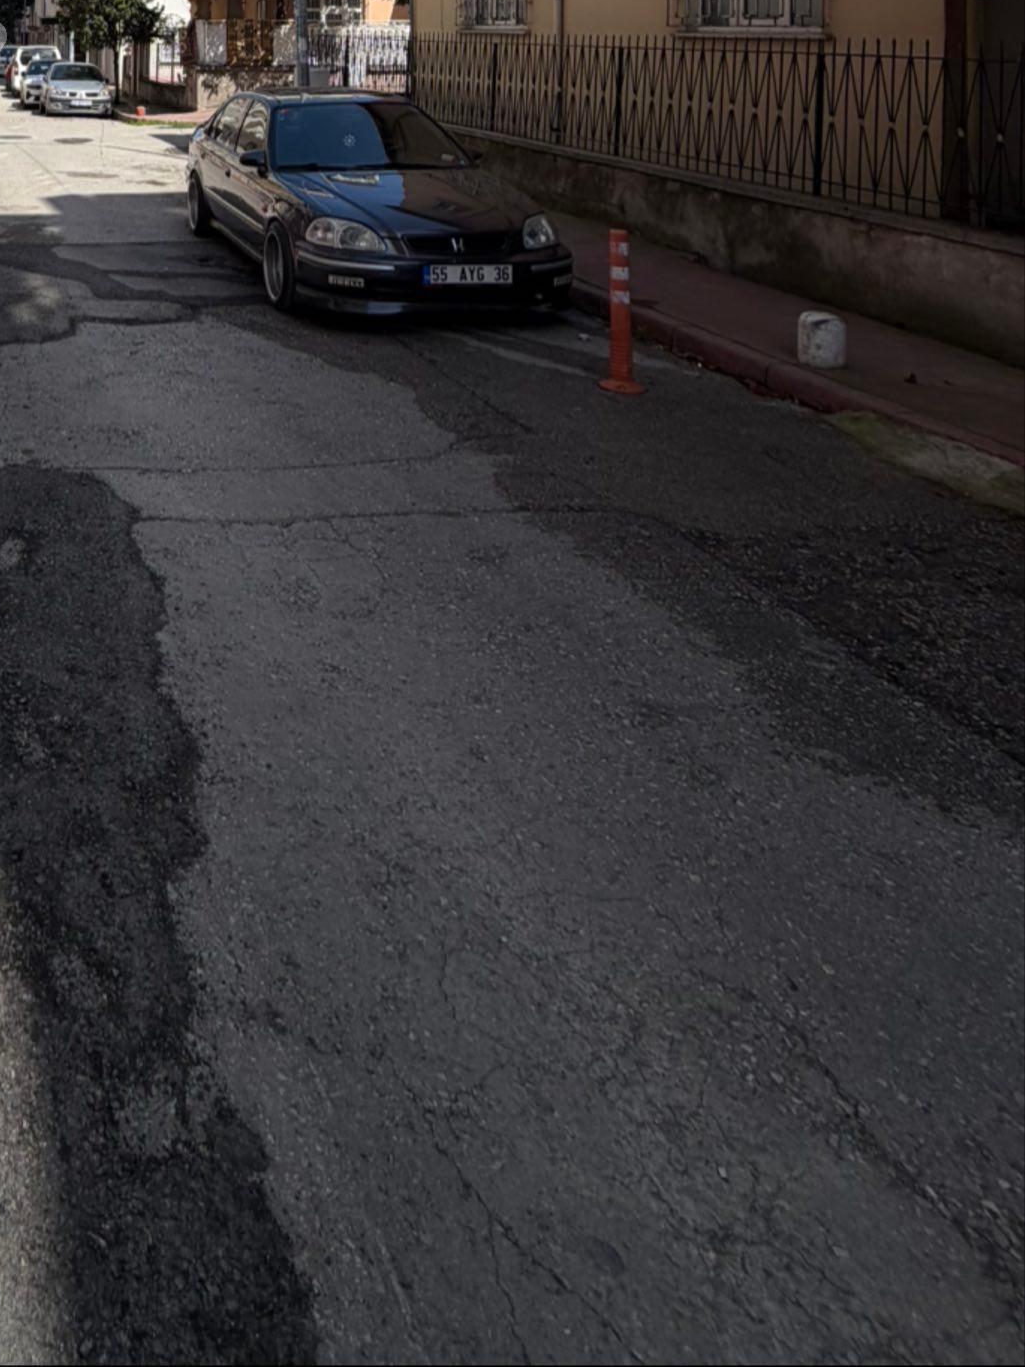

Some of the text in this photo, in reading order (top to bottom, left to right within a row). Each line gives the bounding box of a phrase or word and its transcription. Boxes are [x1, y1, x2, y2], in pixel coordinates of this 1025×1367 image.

[432, 266, 510, 283] 55 AYG 36
